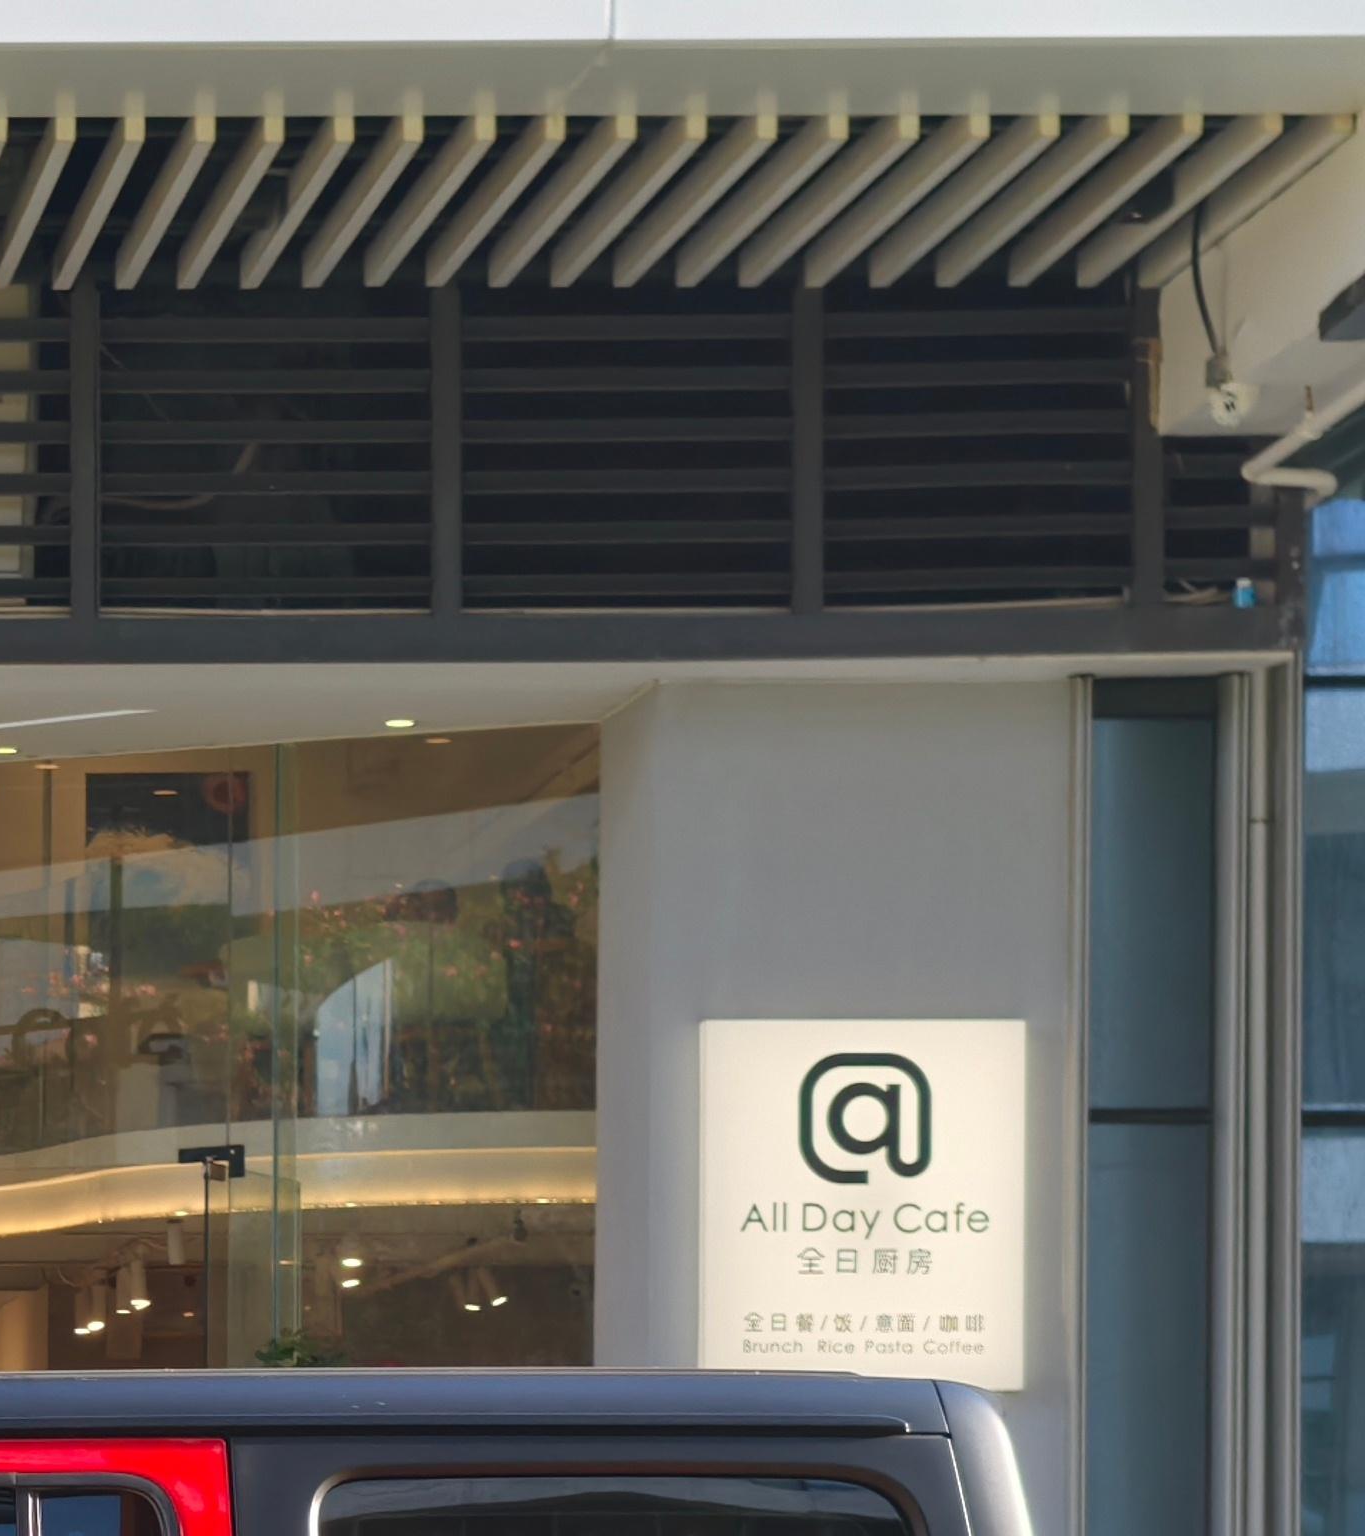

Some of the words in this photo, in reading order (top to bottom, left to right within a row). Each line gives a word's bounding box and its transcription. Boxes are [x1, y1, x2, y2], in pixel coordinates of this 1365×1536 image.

[740, 1202, 787, 1233] All
[801, 1202, 881, 1240] Day
[893, 1202, 990, 1234] Cafe
[797, 1247, 933, 1275] 全日厨房
[742, 1339, 804, 1354] Brunch
[817, 1339, 855, 1354] Rice
[865, 1339, 914, 1354] Pasta
[923, 1338, 985, 1355] Coffee
